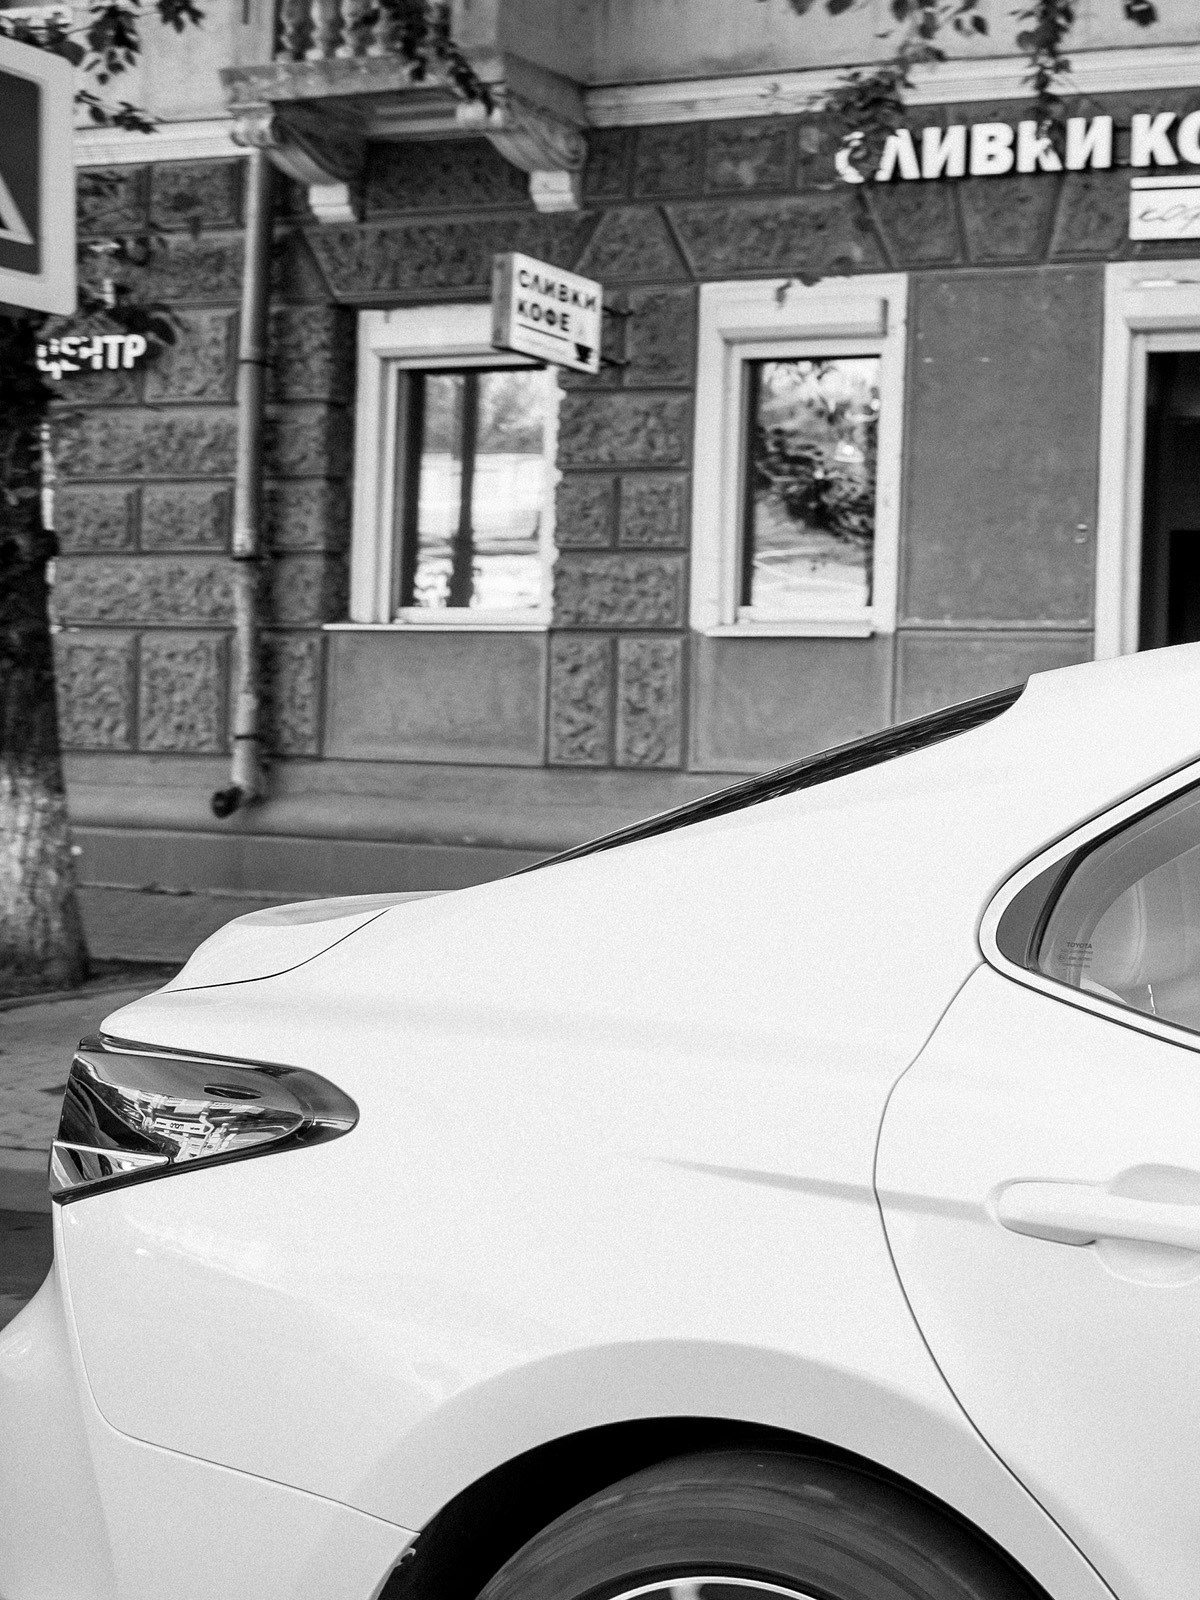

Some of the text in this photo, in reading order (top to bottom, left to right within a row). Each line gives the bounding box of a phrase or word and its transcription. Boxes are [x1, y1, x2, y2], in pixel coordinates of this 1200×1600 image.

[834, 114, 1113, 184] СЛИВКИ
[519, 269, 597, 312] СЛИВКИ
[517, 299, 571, 332] КОФЕ
[1066, 941, 1093, 949] TOYOTA
